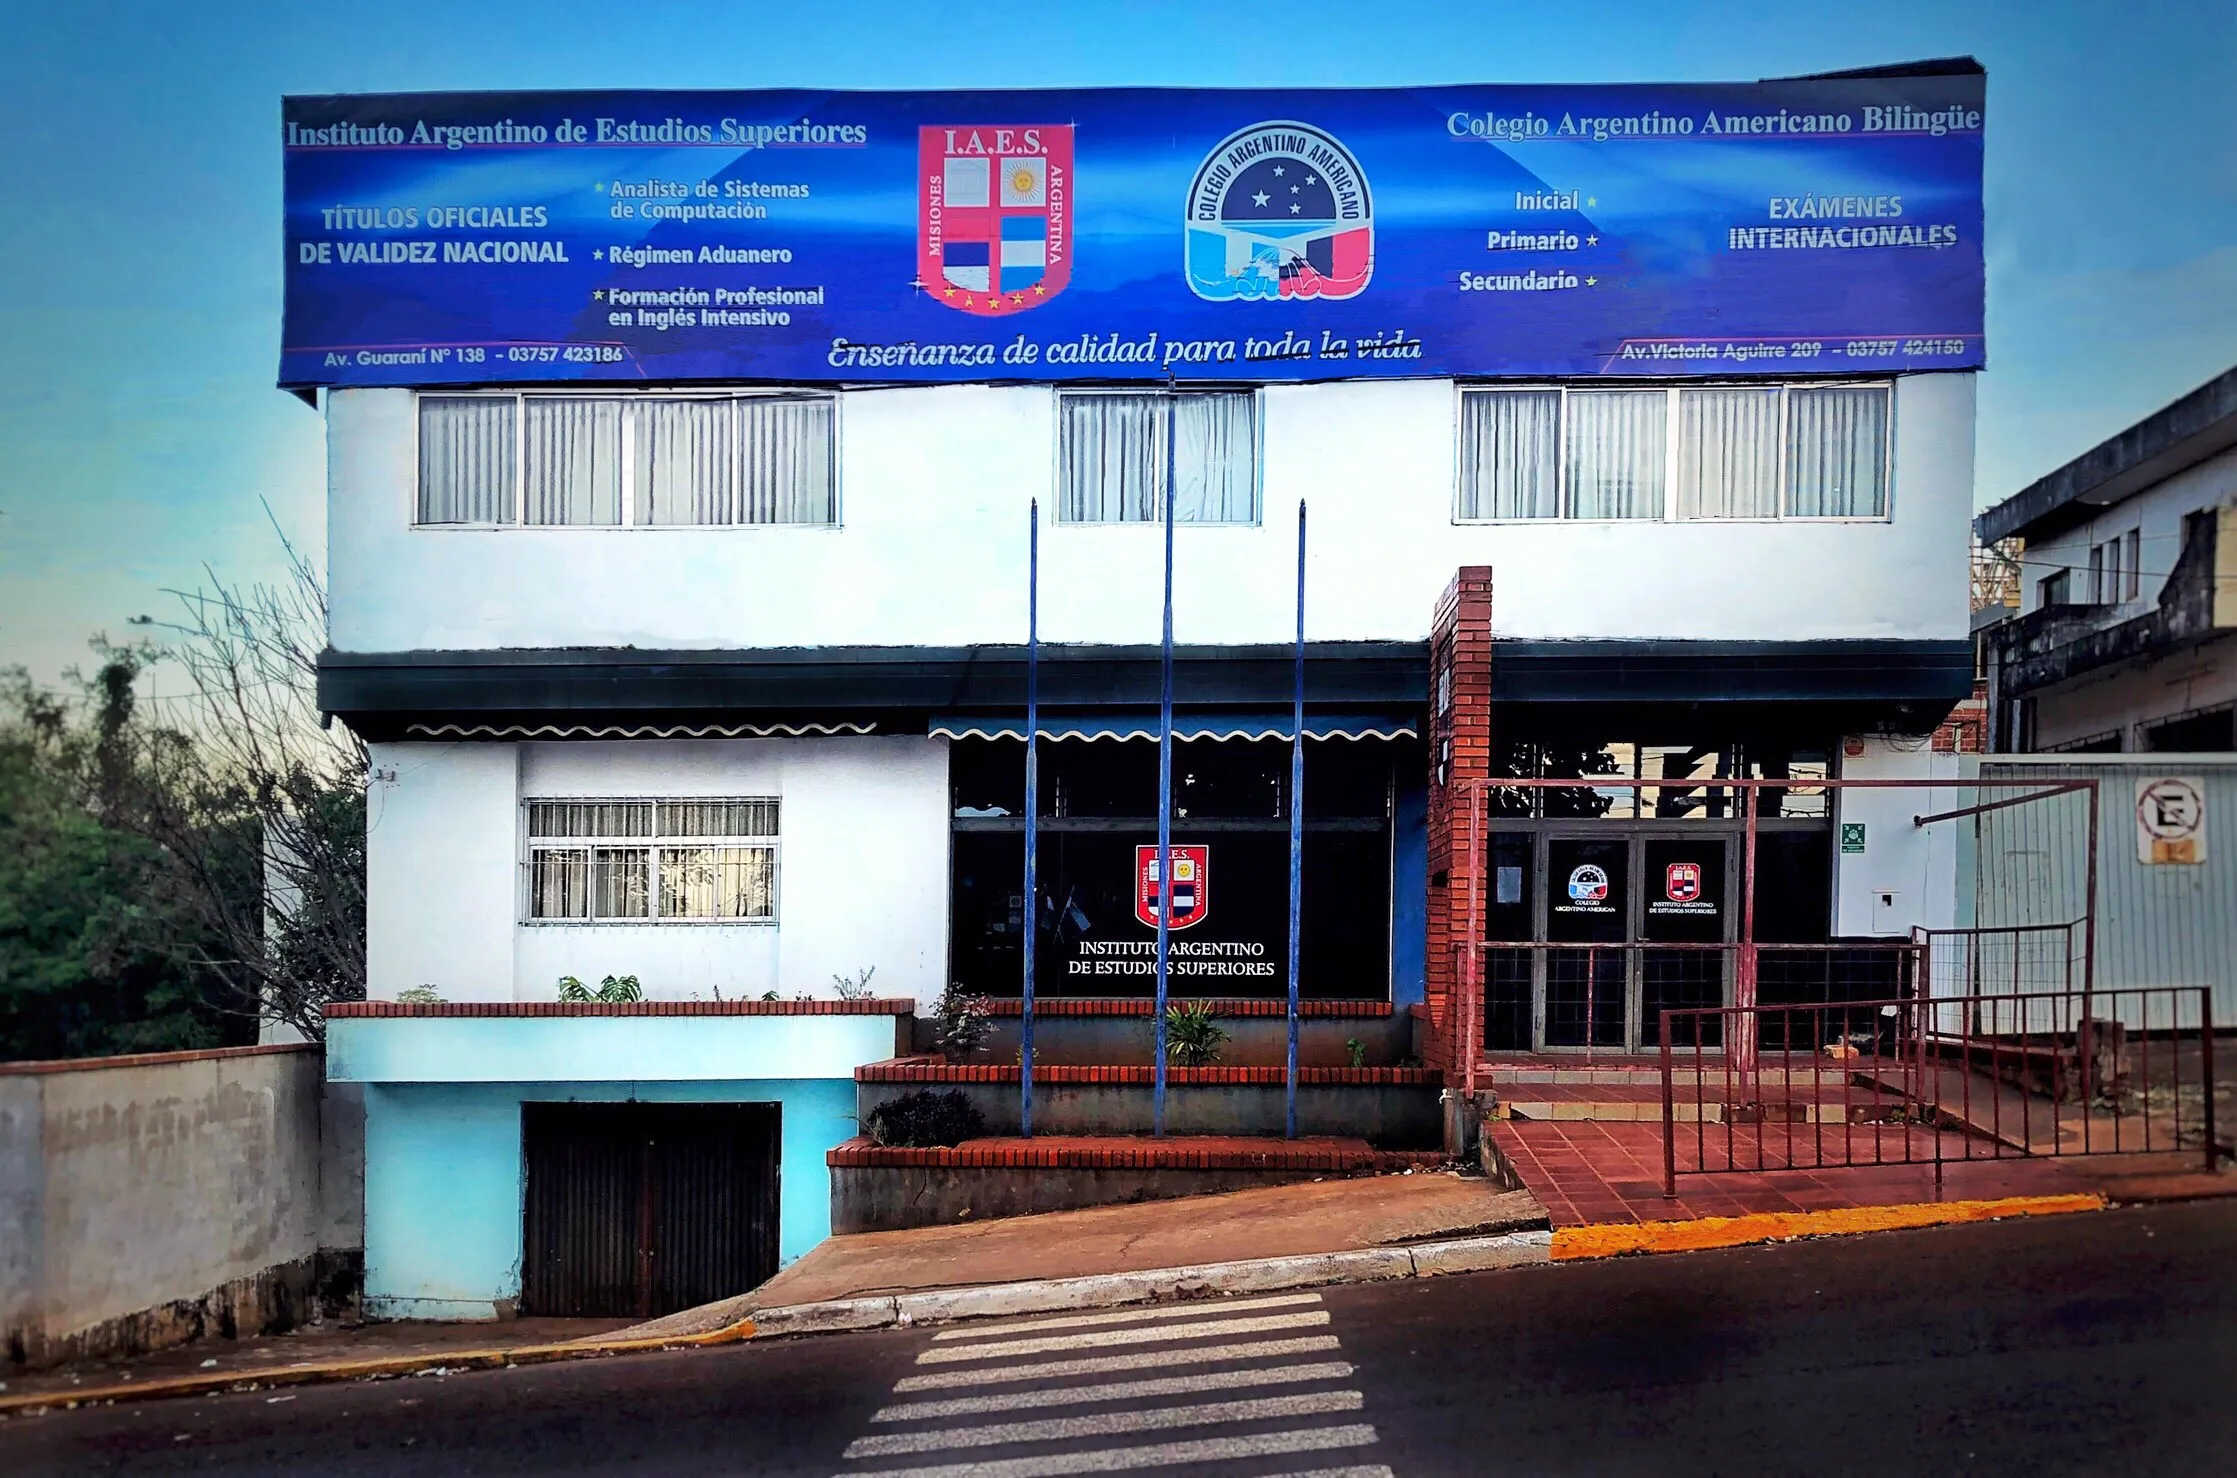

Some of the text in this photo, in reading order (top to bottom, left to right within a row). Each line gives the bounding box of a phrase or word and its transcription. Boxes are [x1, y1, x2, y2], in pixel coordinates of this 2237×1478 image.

[287, 118, 866, 150] Instituto Argentino de Estudios Superiores
[1447, 105, 1980, 142] Colegio Argentino Americano Bilingüe
[944, 129, 1049, 154] I.A.E.S.
[610, 180, 809, 198] Analista de Sistemas
[1198, 134, 1360, 221] COLEGIO ARGENTINO AMERICANO
[1515, 190, 1579, 210] Inicial
[1769, 193, 1903, 219] EXÁMENES
[321, 204, 548, 229] TÍTULOS OFICIALES
[610, 201, 767, 223] de Computación
[929, 175, 942, 257] MISIONES
[1050, 165, 1063, 265] ARGENTINA
[1488, 230, 1579, 250] Primario
[1729, 224, 1958, 249] INTERNACIONALES
[300, 241, 569, 264] DE VALIDEZ NACIONAL
[609, 245, 792, 268] Régimen Aduanero
[1460, 270, 1578, 291] Secundario
[609, 286, 824, 305] Formación Profesional
[608, 308, 791, 331] en Inglés Intensivo
[324, 351, 351, 367] Av.
[356, 349, 425, 365] Guaraní
[456, 348, 486, 363] 138
[508, 347, 558, 362] 03757
[562, 346, 623, 362] 423186
[828, 330, 1422, 370] Enseñanza de calidad para toda la vida
[1722, 342, 1786, 361] Aguirre
[1790, 342, 1821, 358] 209
[1846, 340, 1898, 356] 03757
[1902, 339, 1965, 355] 424150
[1168, 942, 1264, 956] ARGENTINO
[1068, 961, 1091, 974] DE
[1177, 962, 1275, 976] SUPERIORES
